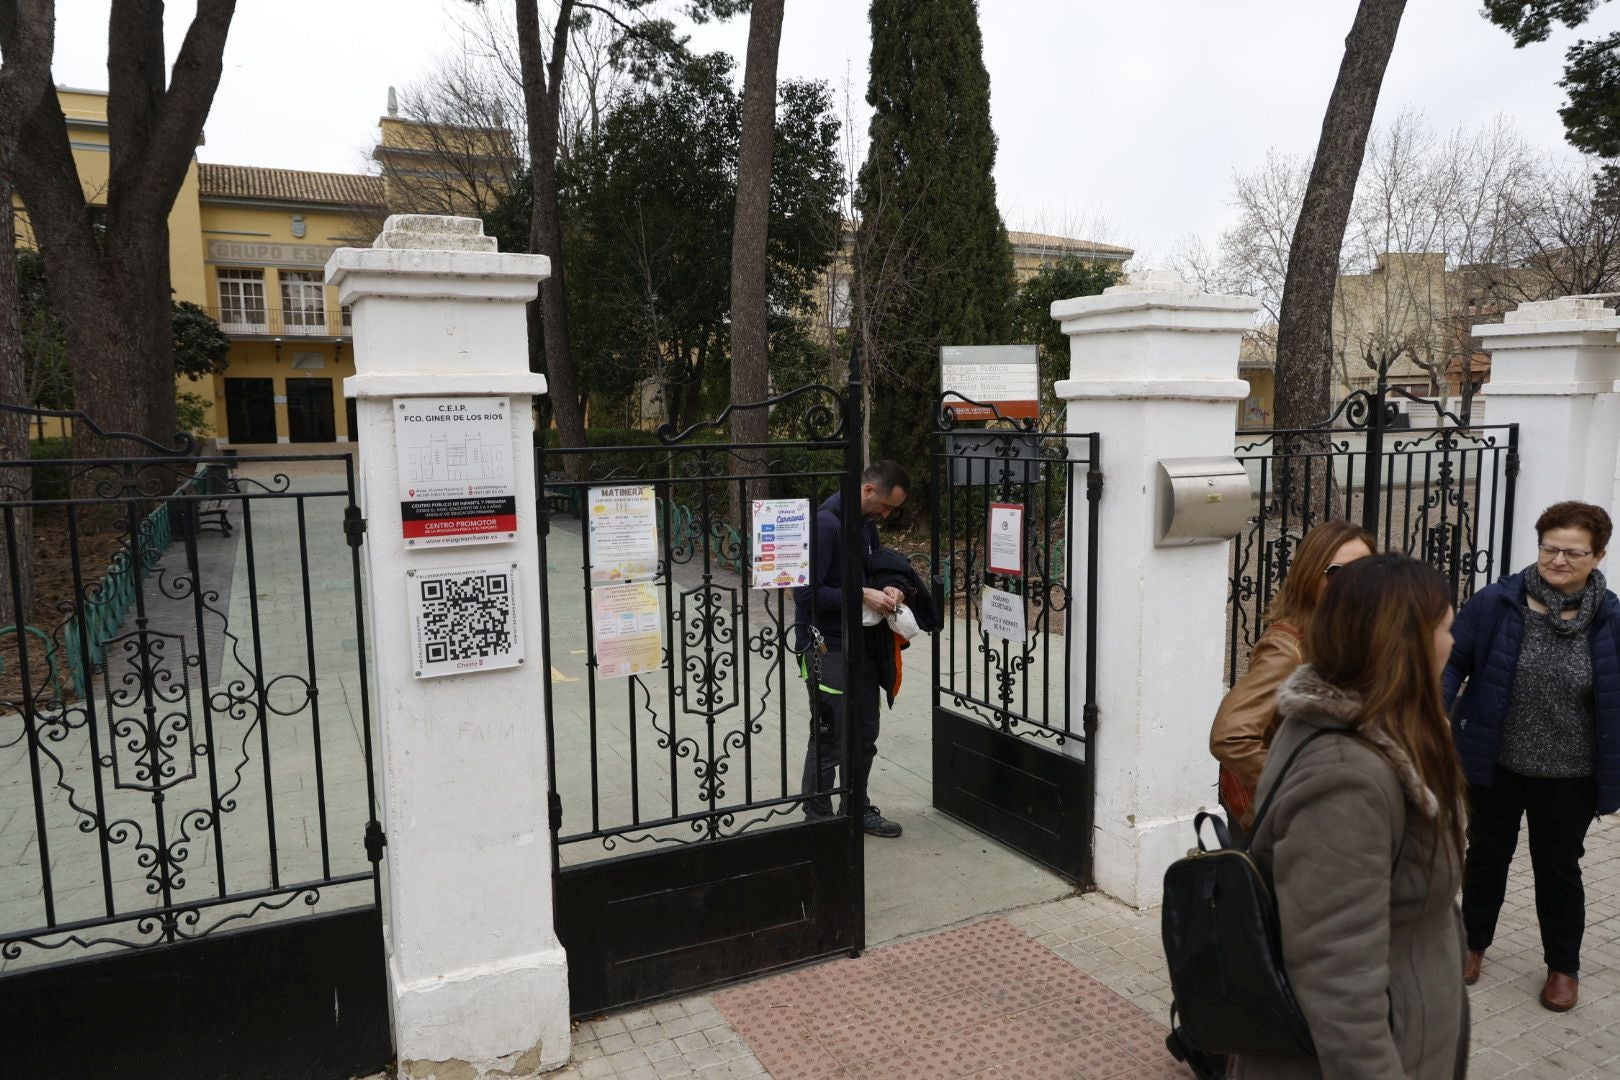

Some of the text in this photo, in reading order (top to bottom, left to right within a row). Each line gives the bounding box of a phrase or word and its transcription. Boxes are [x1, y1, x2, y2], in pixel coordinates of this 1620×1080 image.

[216, 243, 330, 261] GRUPO ESC
[946, 365, 976, 373] Colegio
[946, 383, 977, 391] General
[438, 404, 467, 412] C.E.I.P.
[425, 414, 451, 422] GINER
[601, 486, 643, 497] MATINERA
[776, 513, 805, 523] Carnaval
[425, 519, 497, 530] CENTRO PROMOTOR
